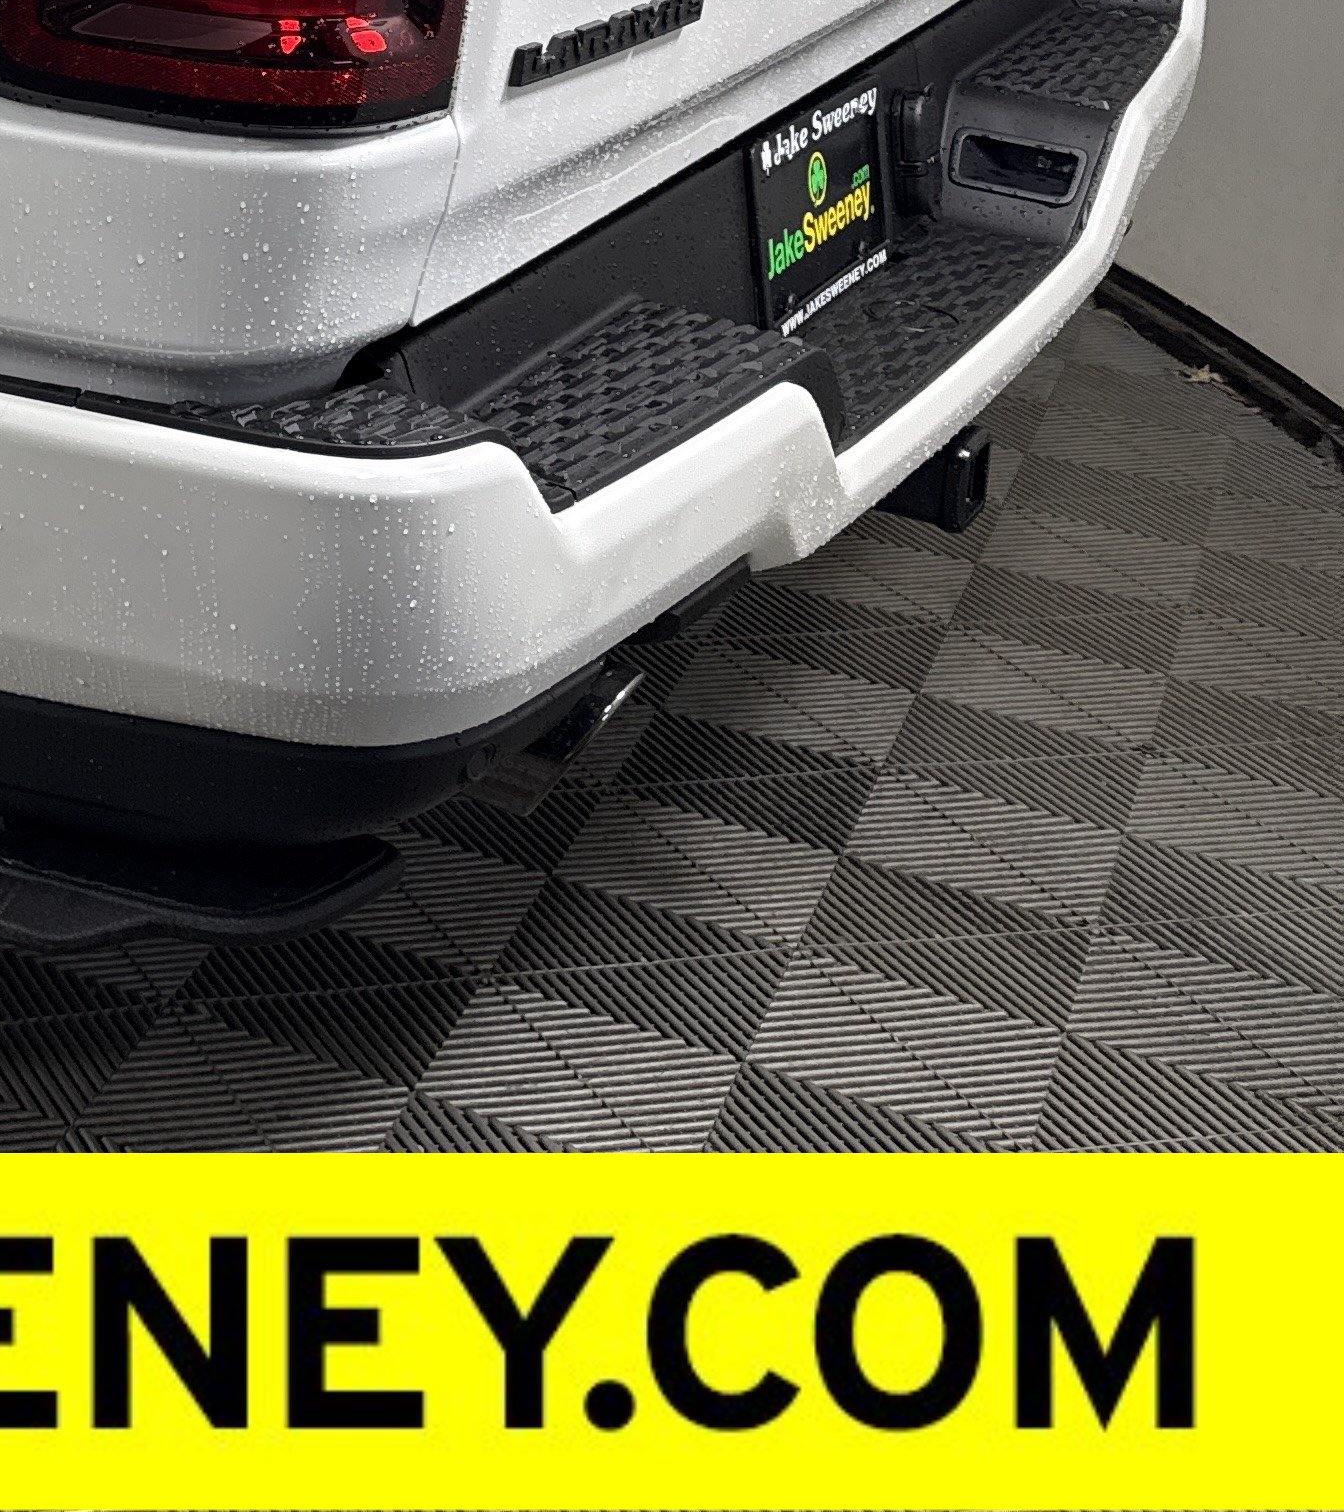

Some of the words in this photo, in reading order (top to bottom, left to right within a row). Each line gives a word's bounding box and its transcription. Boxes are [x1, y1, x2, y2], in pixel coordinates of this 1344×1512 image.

[773, 124, 809, 167] Jake
[812, 86, 878, 141] Sweeney
[780, 248, 888, 338] WWW.JAKESWEENEY.COM
